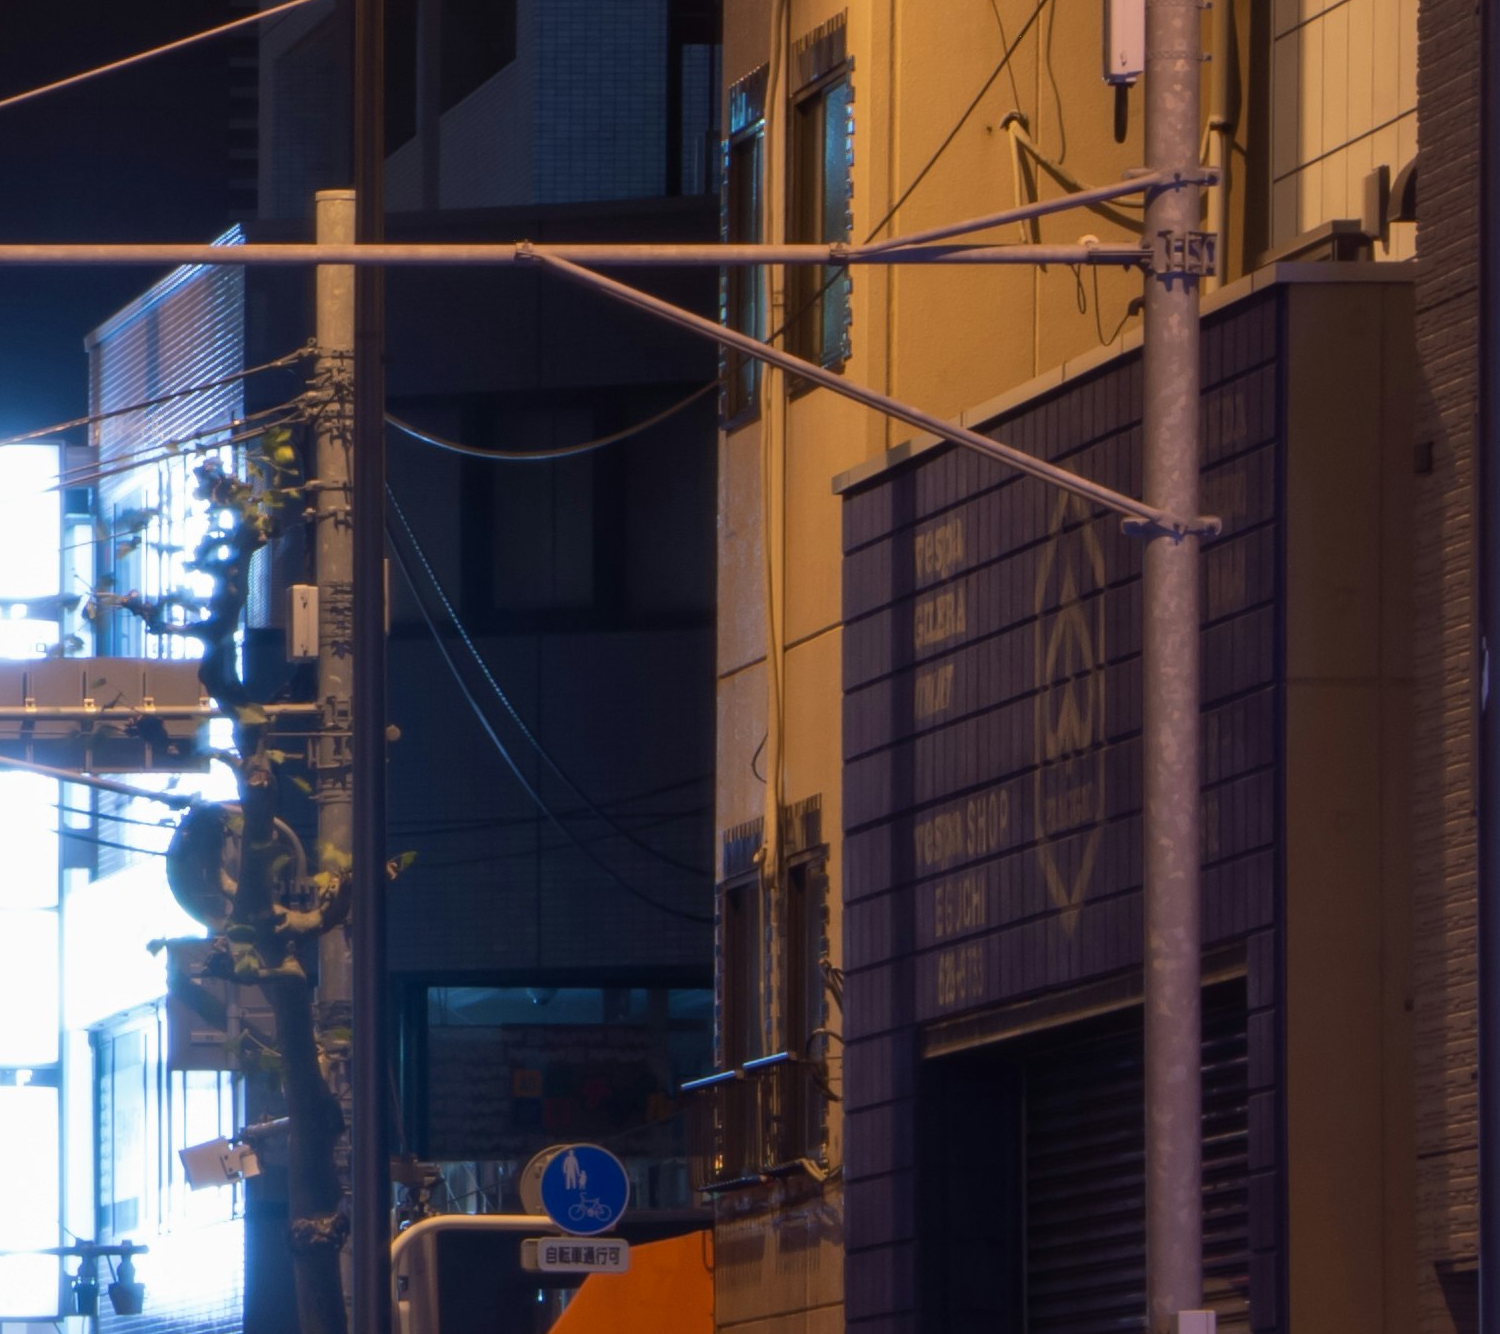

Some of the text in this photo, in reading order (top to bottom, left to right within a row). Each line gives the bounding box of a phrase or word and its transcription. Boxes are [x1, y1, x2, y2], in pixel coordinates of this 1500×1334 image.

[967, 789, 1008, 855] SHOP
[546, 1246, 621, 1265] 自転車通行可
